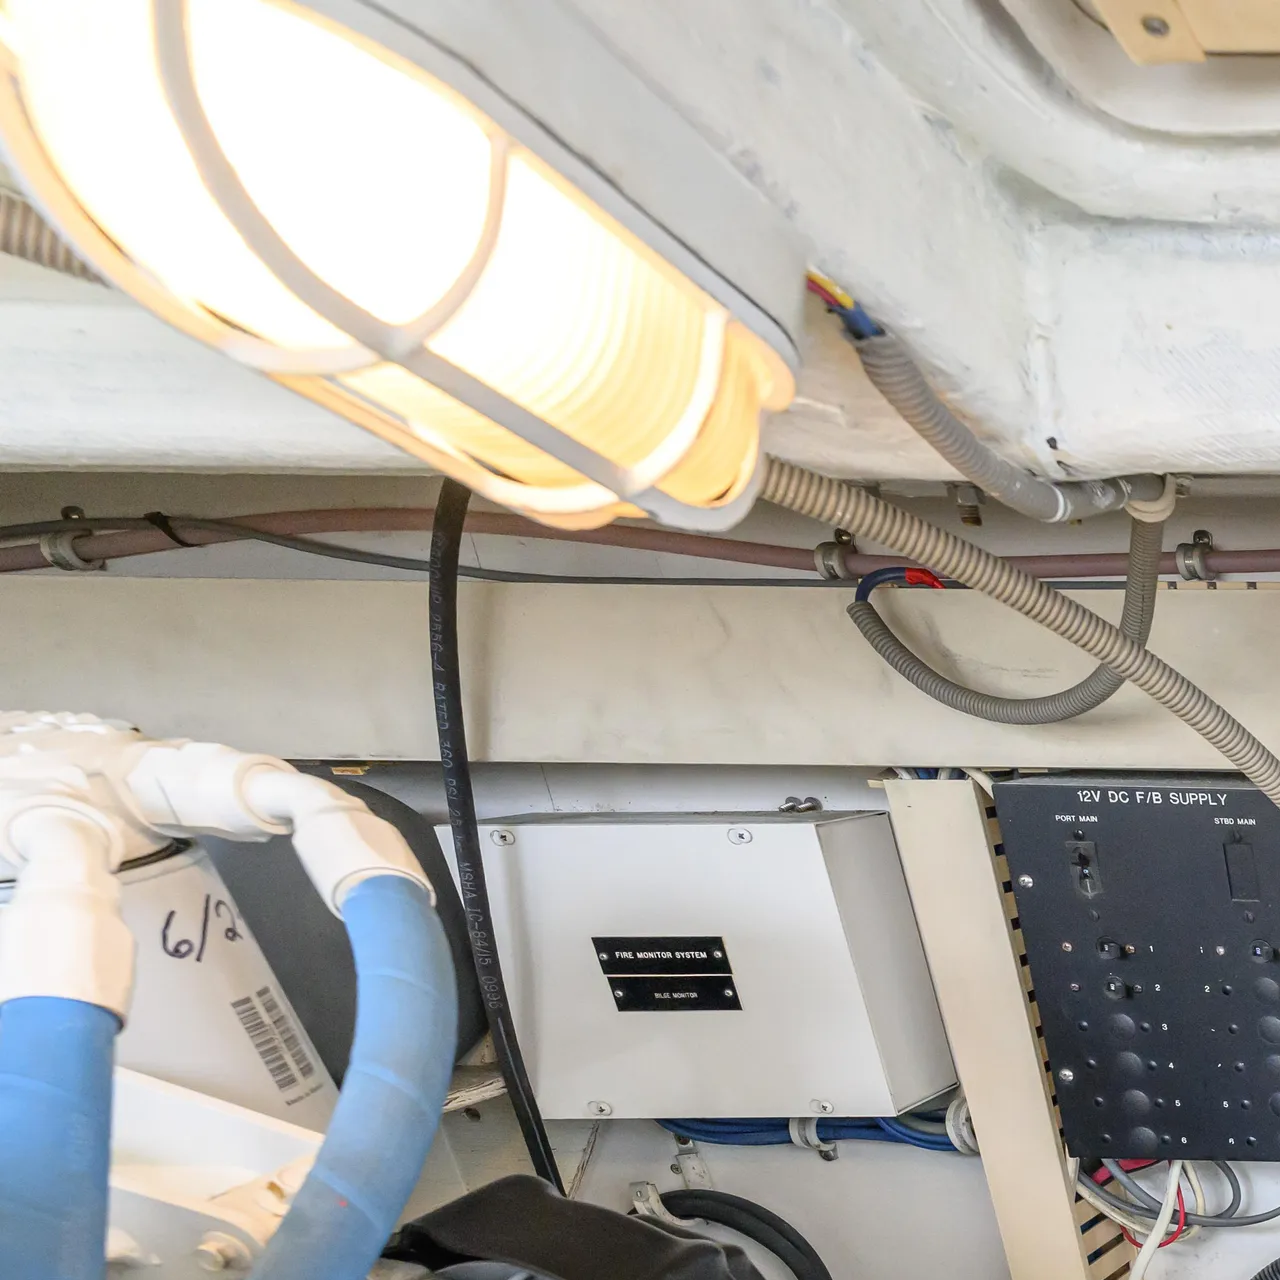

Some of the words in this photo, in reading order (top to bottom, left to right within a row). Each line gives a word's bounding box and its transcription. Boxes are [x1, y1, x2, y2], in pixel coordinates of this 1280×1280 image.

[435, 683, 447, 729] RATED
[1077, 791, 1100, 803] 12V
[1108, 791, 1129, 803] DC
[1136, 792, 1162, 804] F/B
[1169, 793, 1227, 806] SUPPLY
[1237, 818, 1256, 826] MAIN
[460, 862, 476, 898] MSHA
